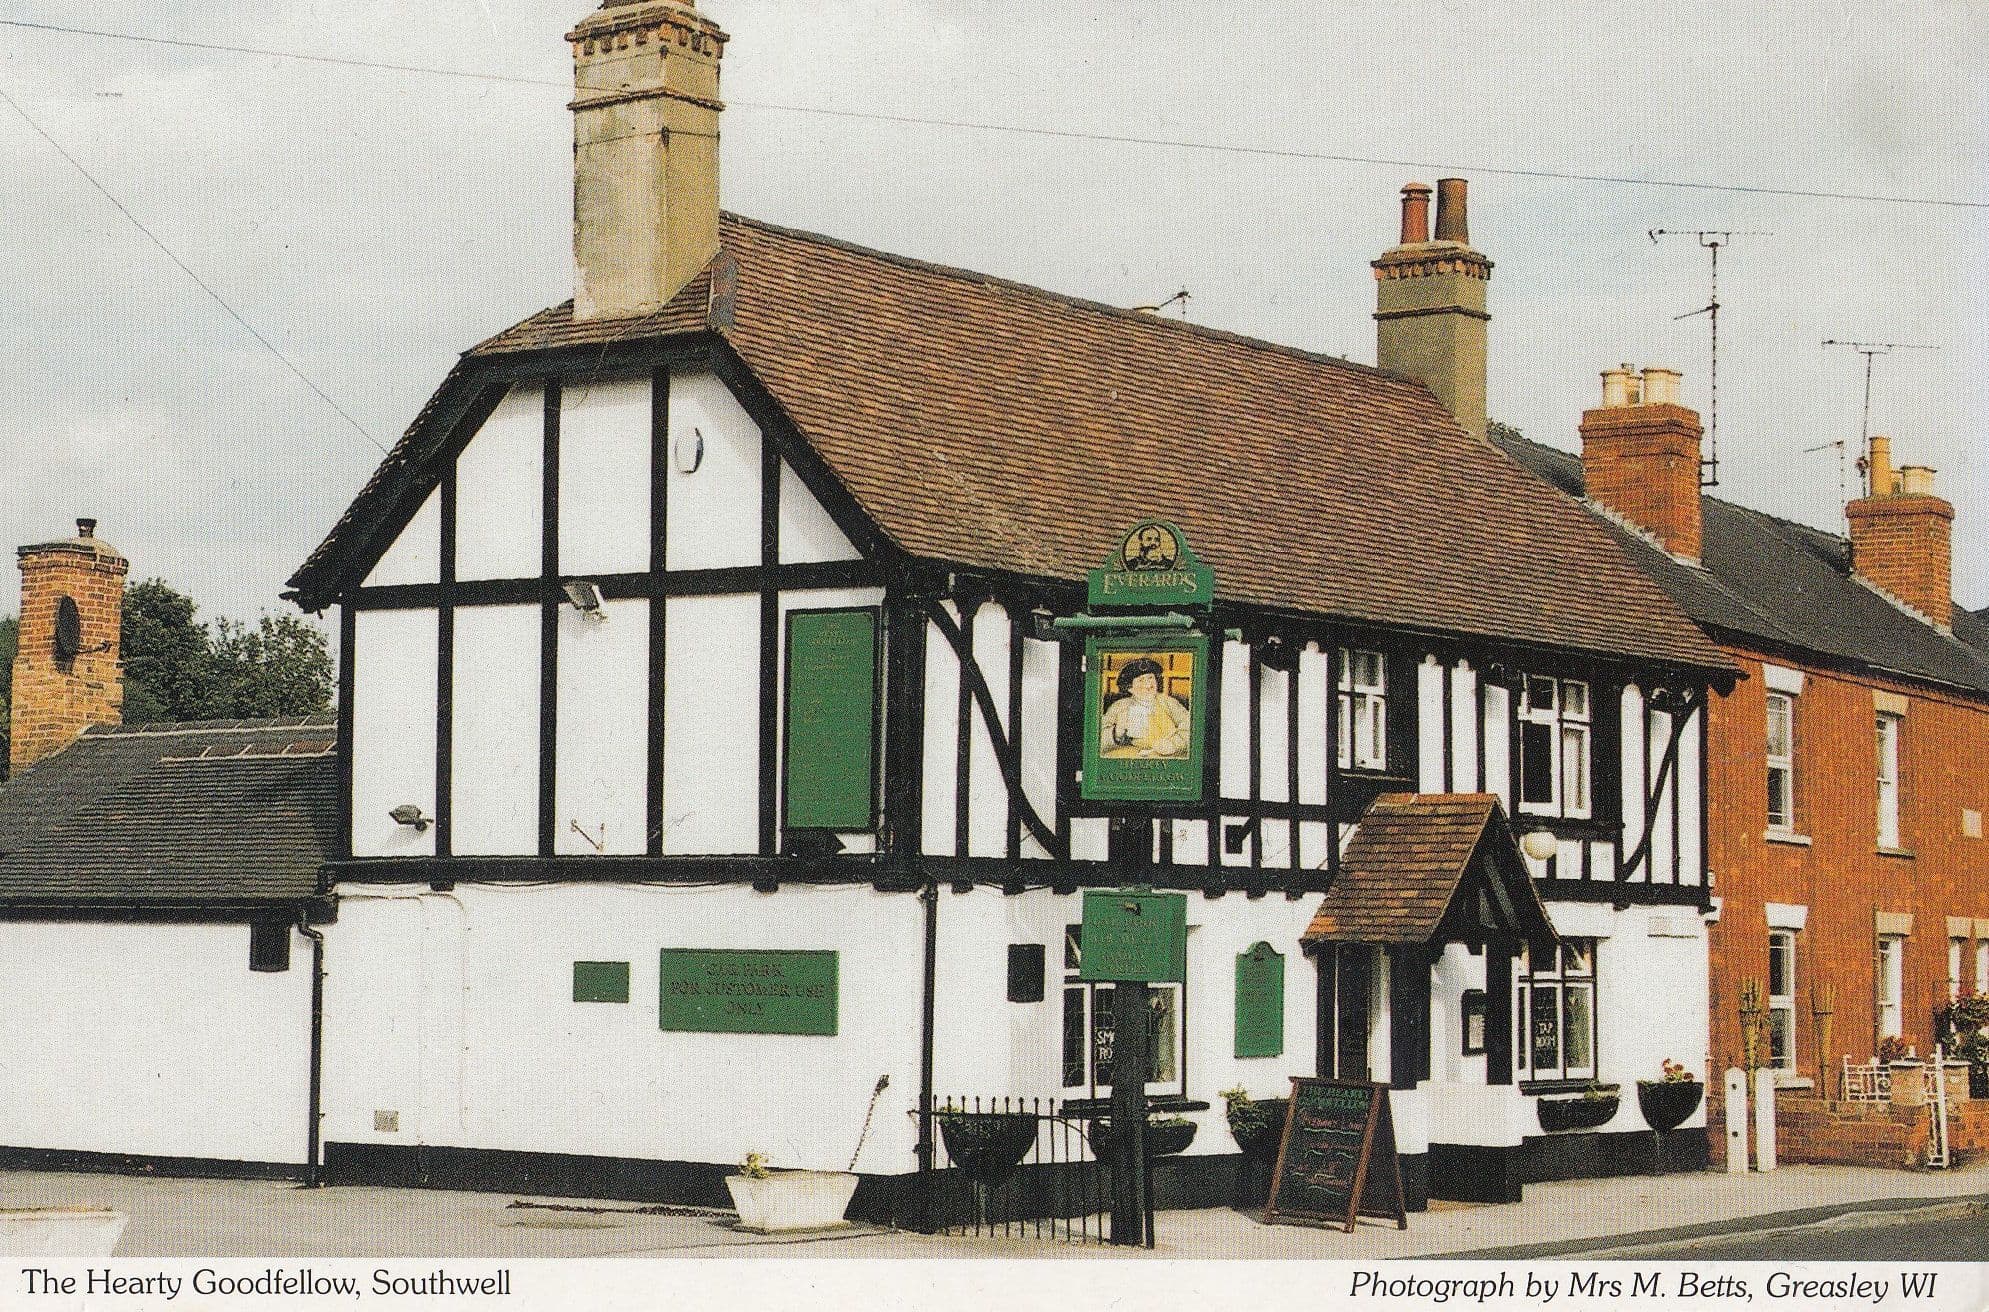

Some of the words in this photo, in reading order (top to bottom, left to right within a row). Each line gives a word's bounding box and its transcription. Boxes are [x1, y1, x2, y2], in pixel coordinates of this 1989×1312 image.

[1103, 571, 1198, 595] EVERARDS
[670, 981, 701, 996] FOR
[705, 983, 792, 998] CUSTOMER
[796, 985, 826, 1000] USE
